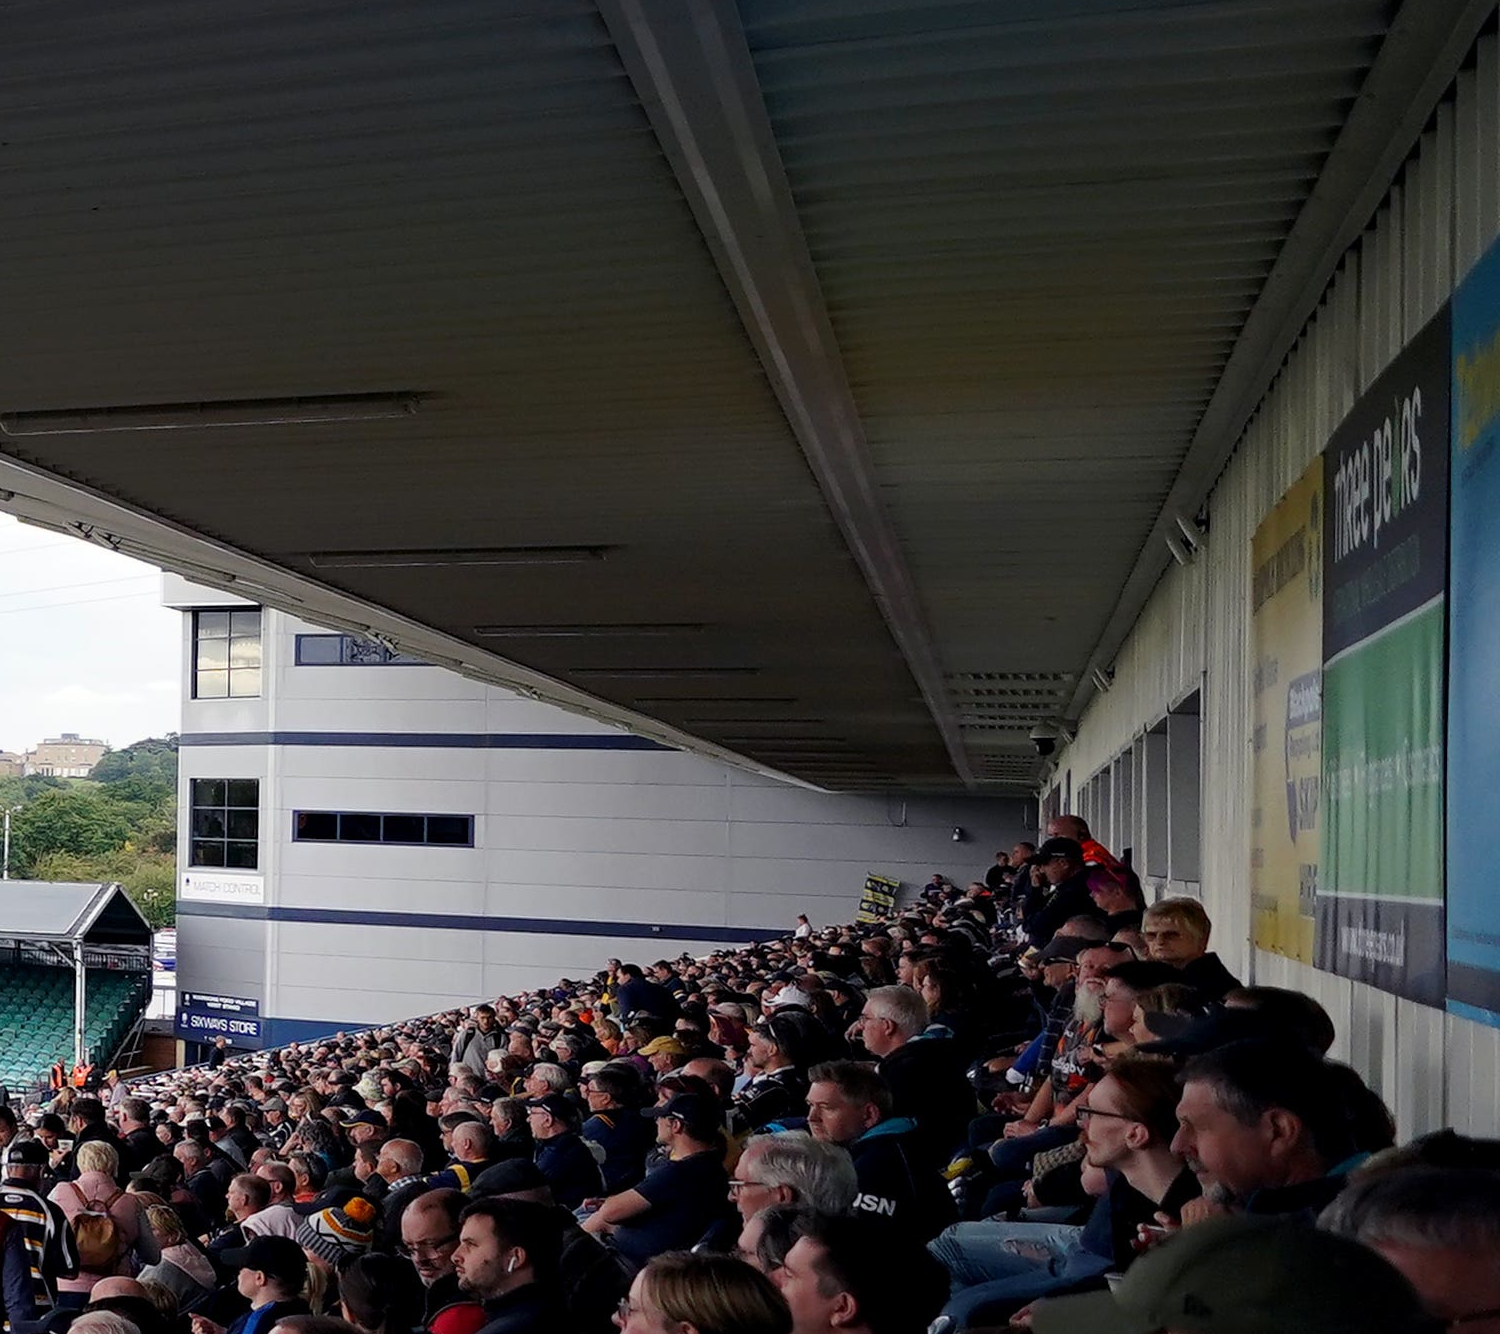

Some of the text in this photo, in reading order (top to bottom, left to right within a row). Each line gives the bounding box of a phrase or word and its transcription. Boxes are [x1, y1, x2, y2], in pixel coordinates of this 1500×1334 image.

[193, 881, 260, 895] MATCH CONTROL
[191, 1015, 257, 1035] SIXWAYS STORE
